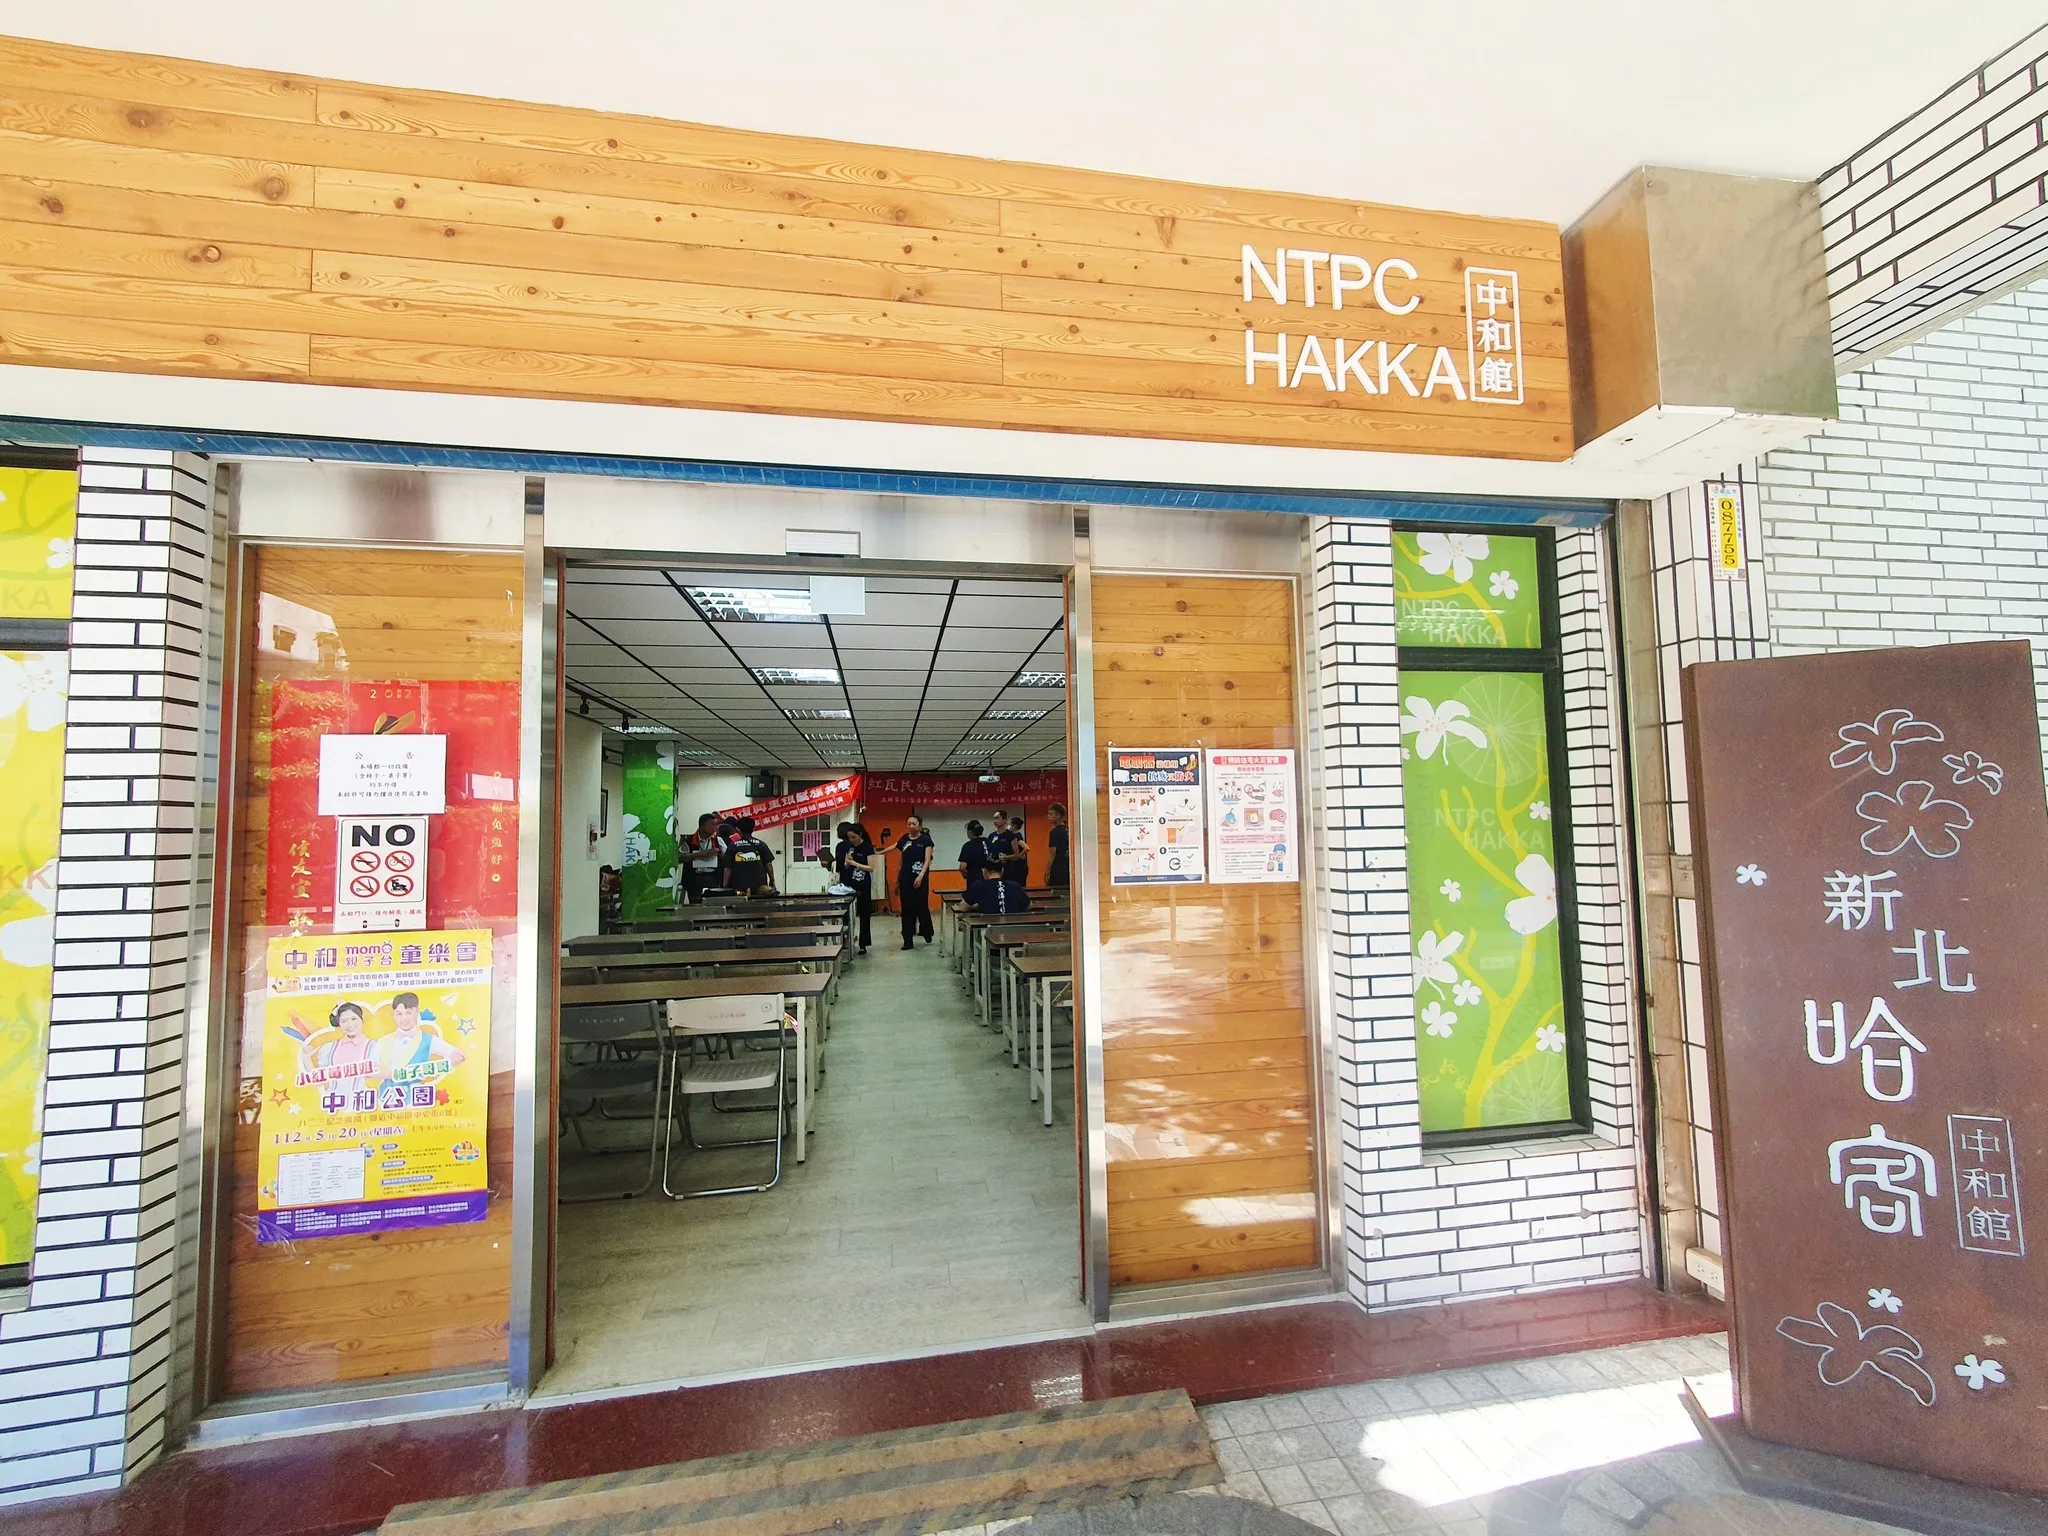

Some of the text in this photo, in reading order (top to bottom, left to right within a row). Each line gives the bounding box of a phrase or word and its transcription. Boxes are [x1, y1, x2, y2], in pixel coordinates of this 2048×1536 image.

[1241, 243, 1421, 316] NTPC
[1244, 328, 1468, 402] HAKKA
[1475, 277, 1515, 394] 中和館
[1721, 500, 1736, 566] 087755
[351, 824, 416, 847] NO
[284, 947, 338, 970] 中和
[400, 941, 477, 965] 童樂會
[322, 1085, 434, 1113] 中和公園
[1803, 994, 1939, 1239] 哈客
[1960, 1125, 2012, 1244] 中和館
